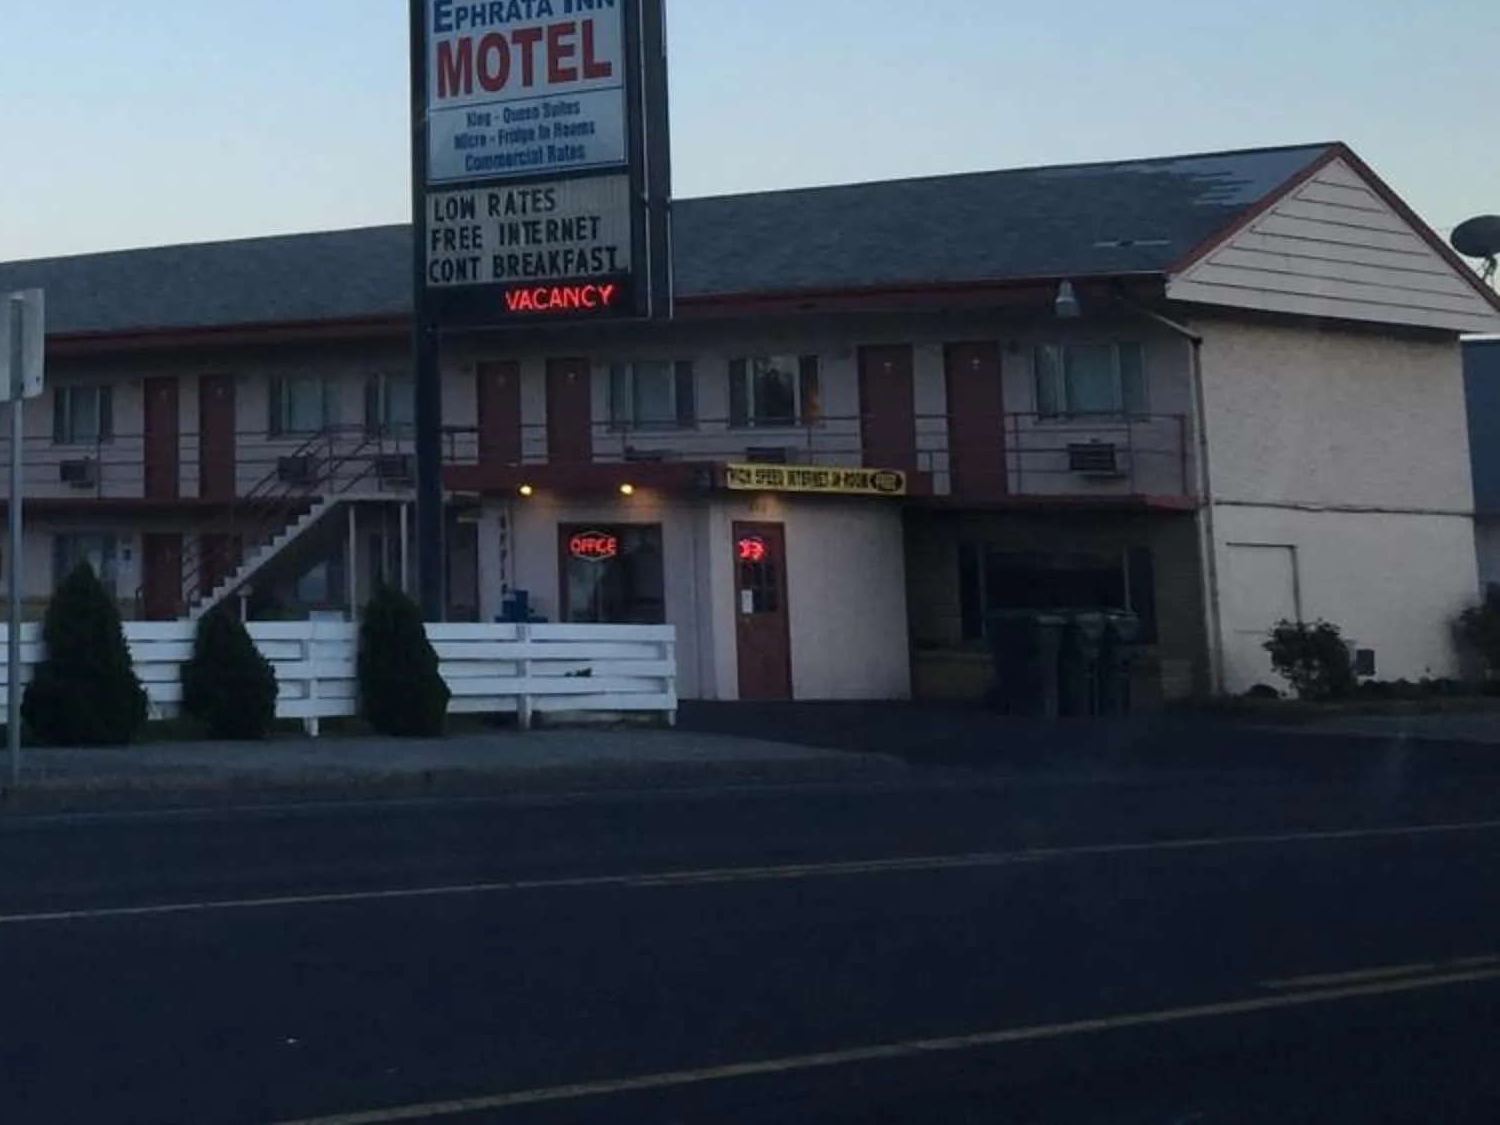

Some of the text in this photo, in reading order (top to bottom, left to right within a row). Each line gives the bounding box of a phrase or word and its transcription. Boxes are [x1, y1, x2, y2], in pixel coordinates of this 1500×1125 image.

[437, 19, 612, 99] MOTEL
[465, 144, 586, 172] Commercial Rates
[434, 188, 556, 223] LOW RATES
[431, 216, 602, 252] FREE INTERNET
[429, 245, 618, 283] CONT BREAKFAST
[506, 283, 614, 311] VACANCY
